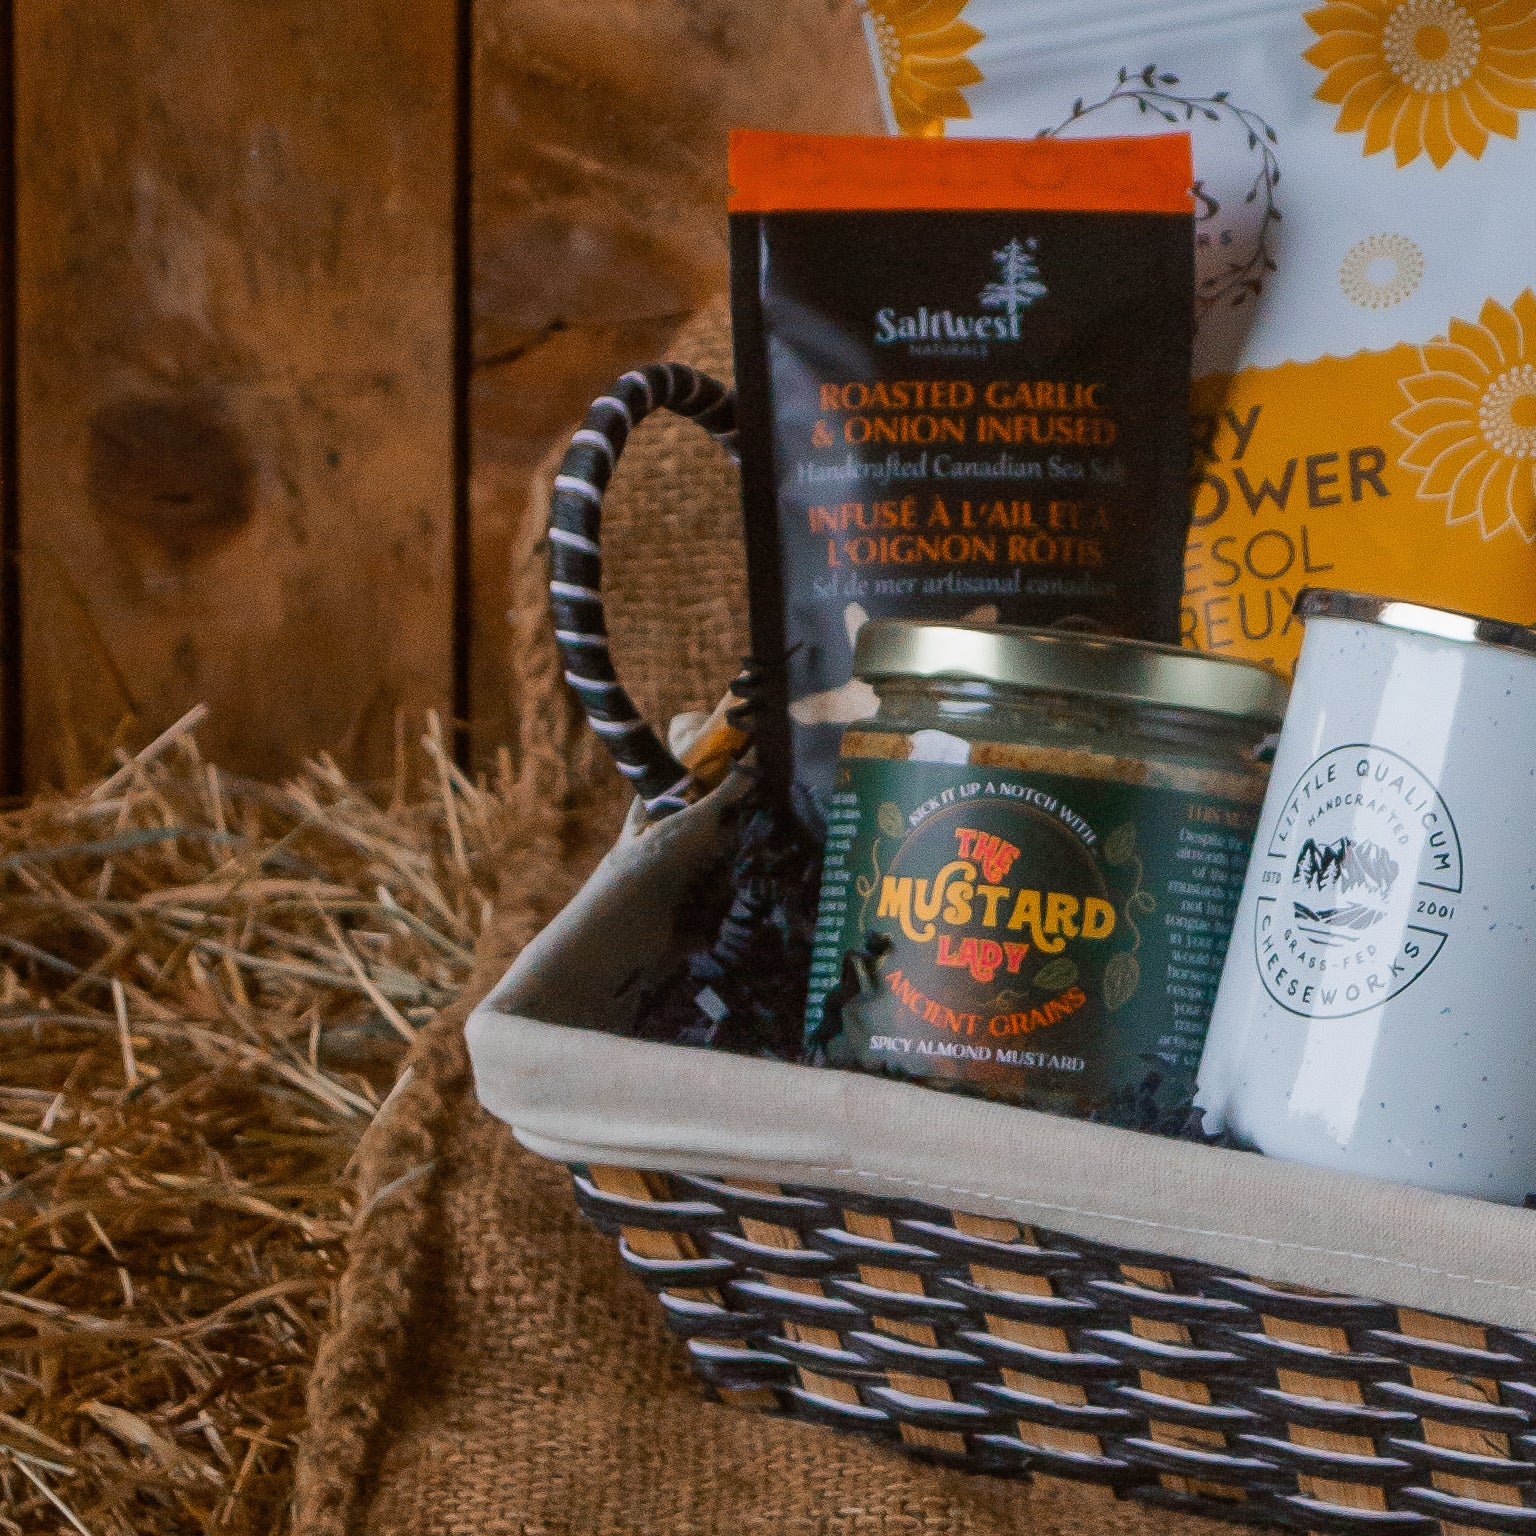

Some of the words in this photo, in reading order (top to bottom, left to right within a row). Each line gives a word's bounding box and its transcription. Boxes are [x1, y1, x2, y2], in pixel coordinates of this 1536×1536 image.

[820, 381, 975, 411] ROASTED
[985, 381, 1105, 410] GARLIC
[811, 418, 834, 449] &
[843, 415, 967, 446] ONION
[977, 415, 1118, 447] INFUSED
[798, 449, 928, 484] Handcrafted
[933, 452, 1042, 479] Canadian
[1049, 454, 1084, 480] Sea
[808, 494, 918, 534] INFUSÉ
[927, 492, 951, 529] À
[962, 501, 1033, 529] L'AIL
[1049, 501, 1080, 530] ET
[827, 534, 997, 568] L'OIGNON
[844, 571, 868, 596] de
[874, 577, 918, 597] mer
[922, 569, 1022, 597] artisanal
[959, 782, 981, 798] UP
[984, 781, 996, 796] A
[1000, 782, 1058, 812] NOTCH
[1059, 804, 1097, 845] WITH
[1277, 763, 1338, 843] LITTLE
[1355, 758, 1451, 871] QUALICUM
[1307, 793, 1410, 847] HANDCRAFTED
[954, 825, 1022, 884] THE
[876, 860, 1118, 954] MUSTARD
[1416, 900, 1455, 920] 2001
[935, 935, 1030, 983] LADY
[1261, 914, 1421, 1006] CHEESEWORKS
[884, 969, 982, 1036] ANCIENT
[988, 986, 1087, 1038] GRAINS
[869, 1035, 914, 1054] SPICY
[916, 1039, 992, 1061] ALMOND
[995, 1048, 1086, 1073] MUSTARD
